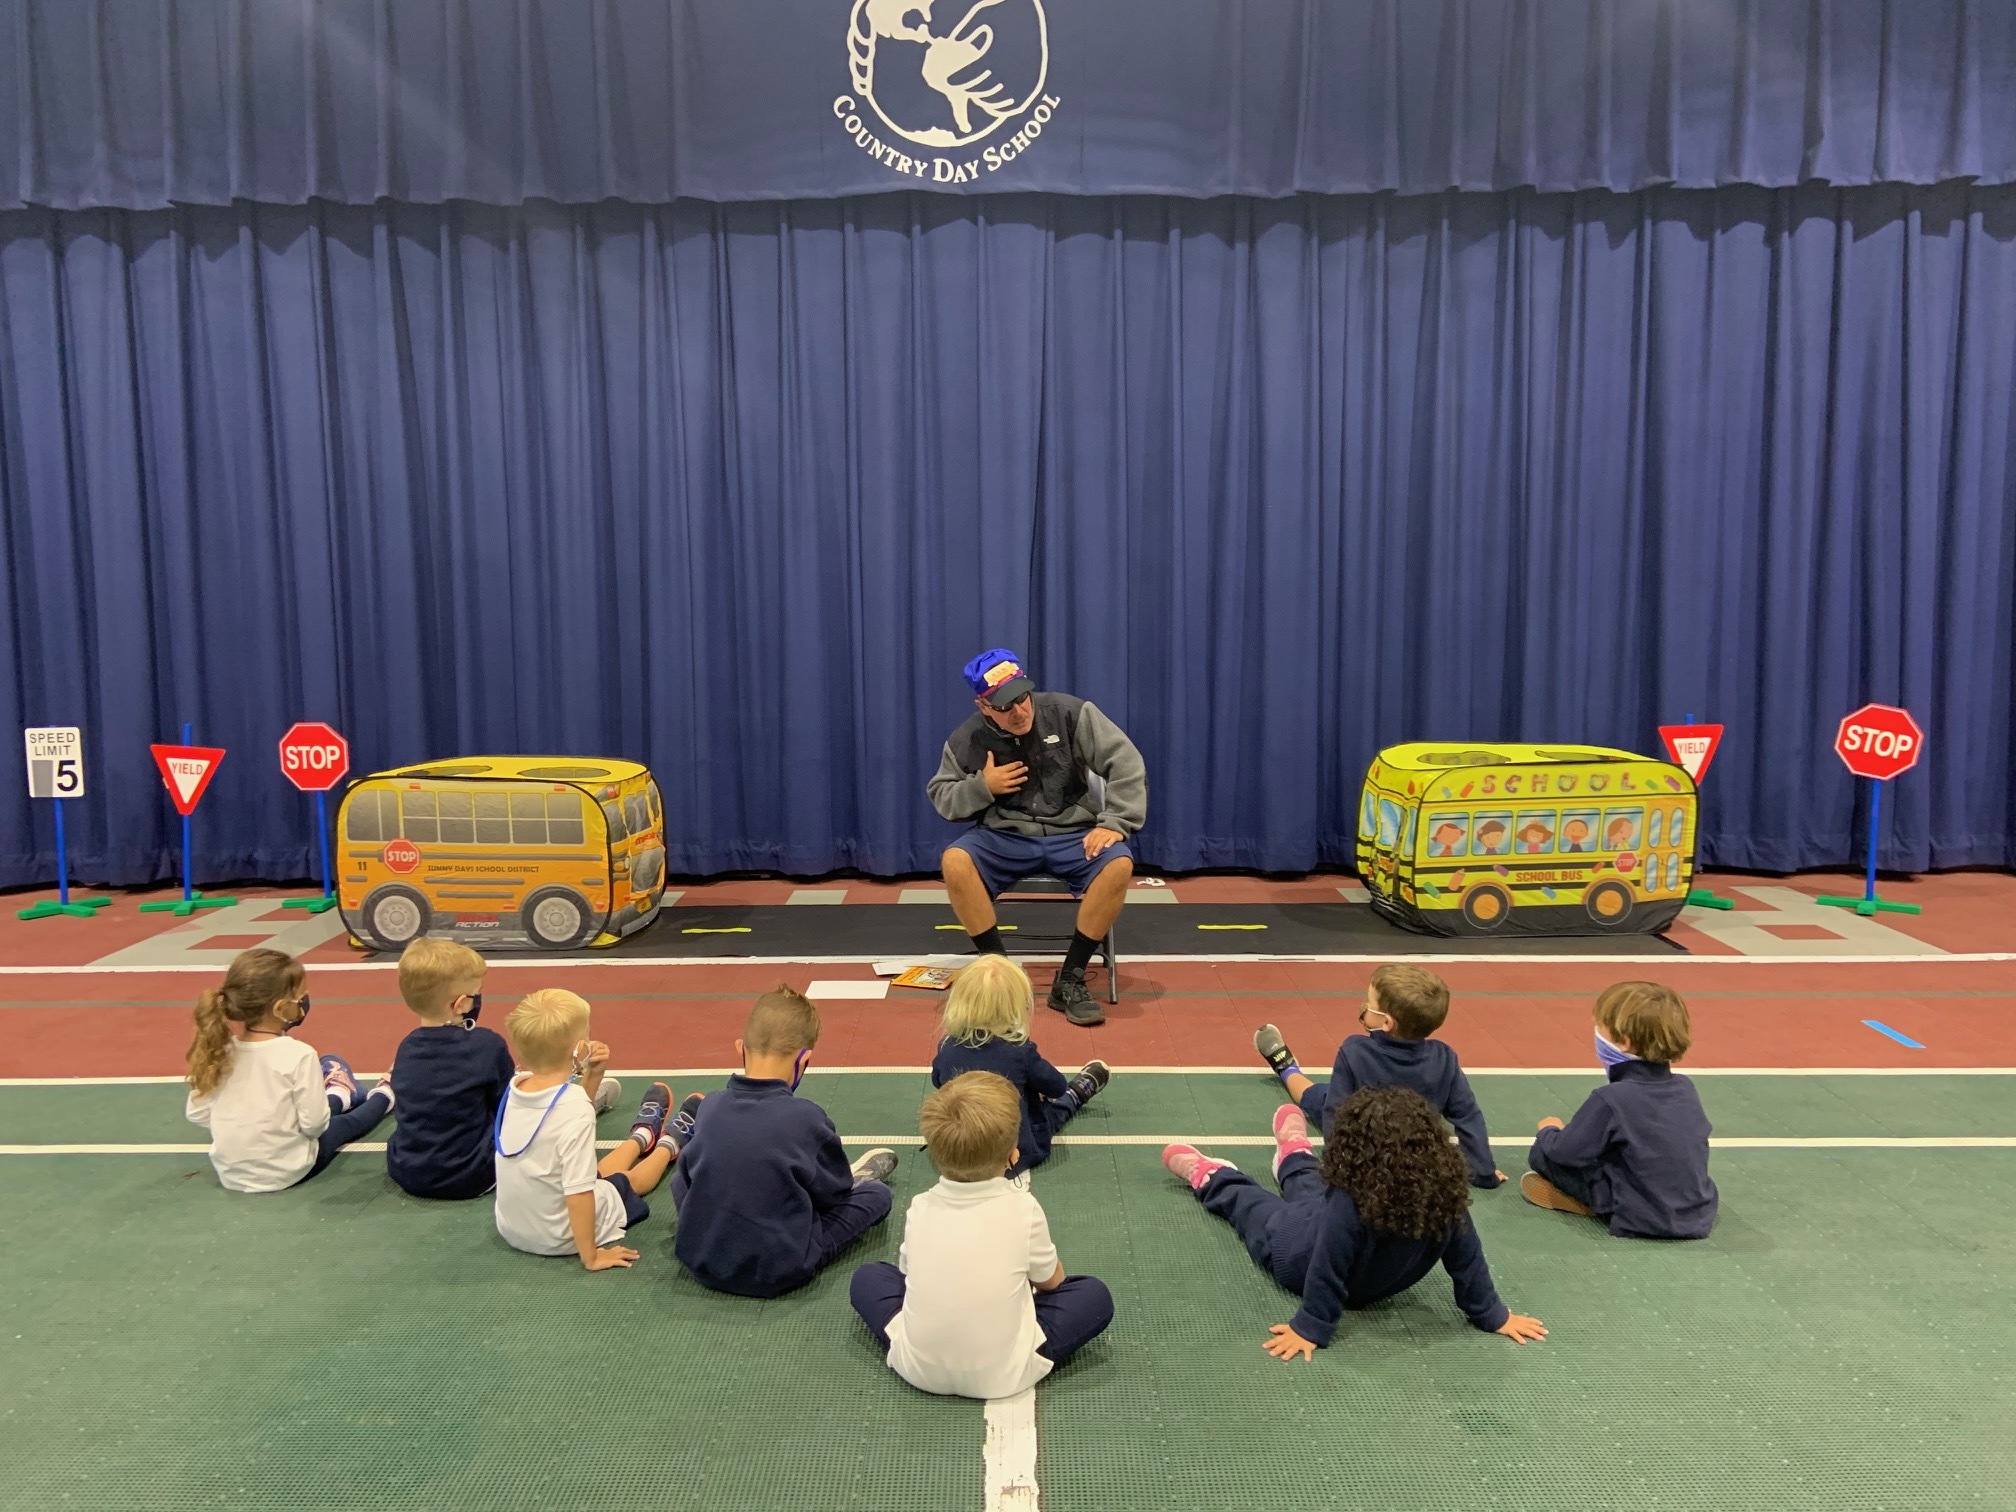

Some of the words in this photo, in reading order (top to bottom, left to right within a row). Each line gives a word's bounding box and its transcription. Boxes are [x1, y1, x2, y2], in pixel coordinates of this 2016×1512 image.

[29, 732, 76, 744] SPEED
[1843, 725, 1913, 759] STOP
[34, 745, 71, 756] LIMIT
[1676, 741, 1706, 754] YIELD
[285, 745, 340, 770] STOP
[56, 759, 79, 792] 5
[171, 763, 204, 776] YIELD
[1481, 771, 1636, 794] SCHOOL
[387, 850, 417, 862] STOP
[1616, 858, 1634, 867] STOP
[357, 861, 367, 871] 11
[1515, 872, 1558, 883] SCHOOL
[1561, 870, 1583, 880] BUS
[1273, 1050, 1287, 1062] AIR
